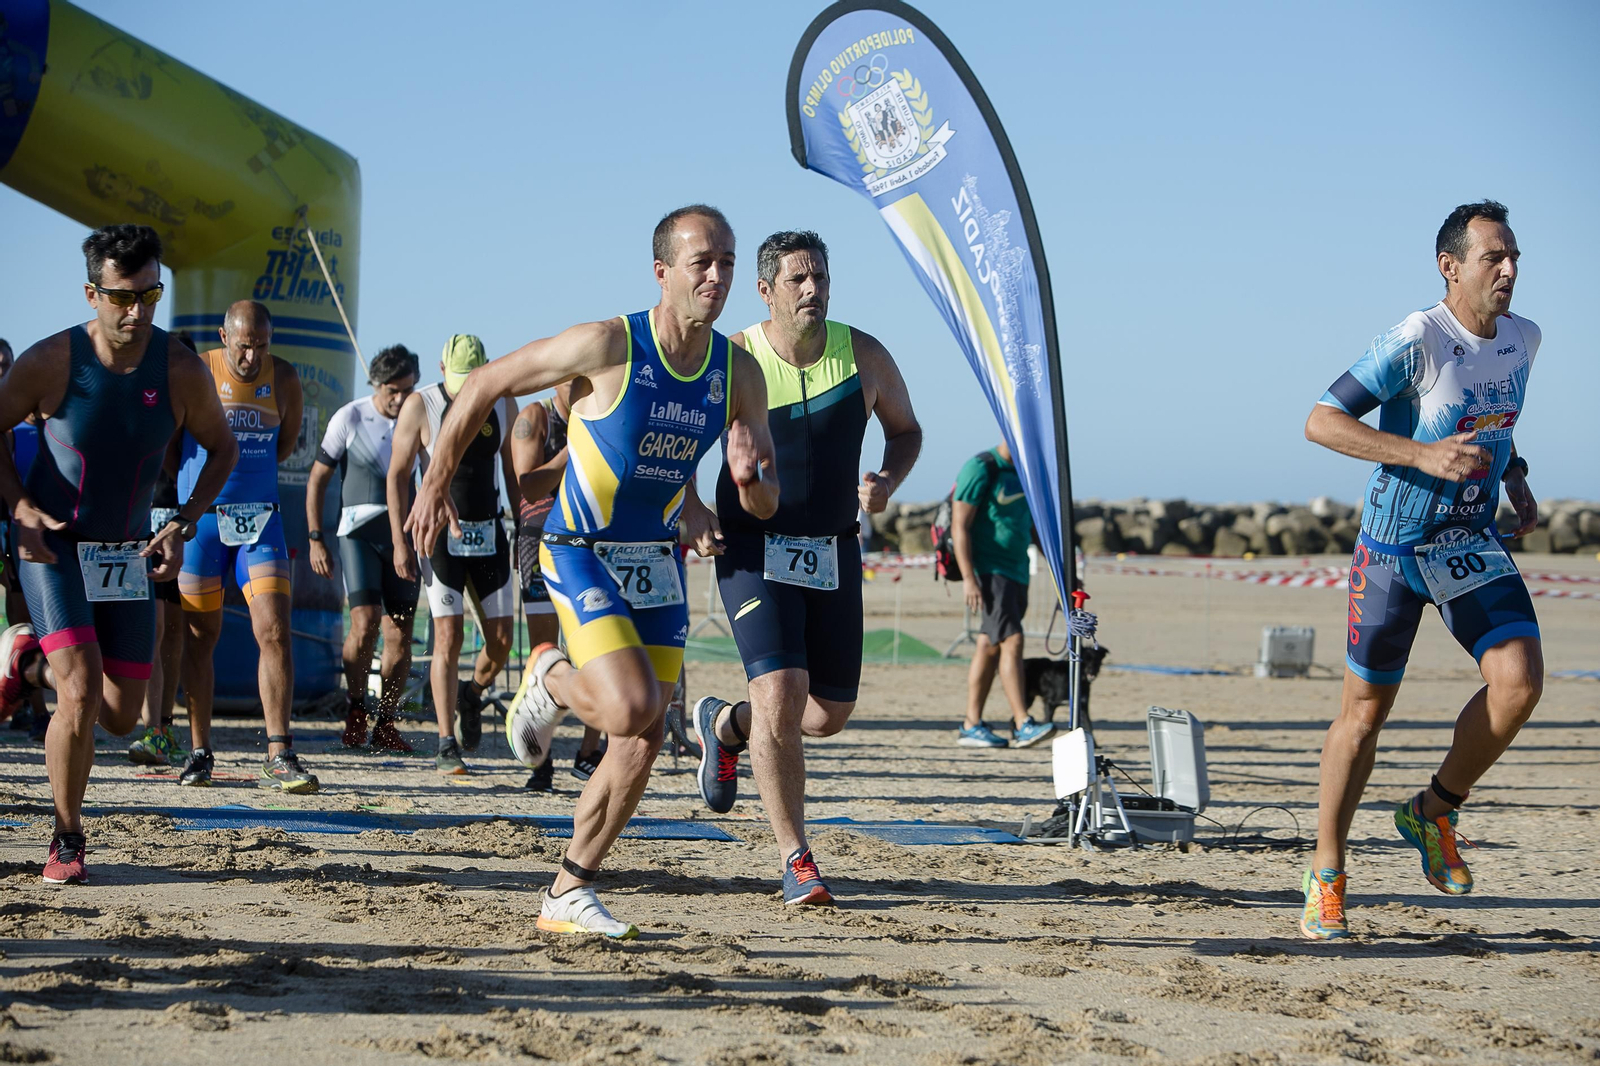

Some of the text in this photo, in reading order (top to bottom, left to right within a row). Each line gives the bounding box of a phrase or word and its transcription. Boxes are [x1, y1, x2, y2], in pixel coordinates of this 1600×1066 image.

[1472, 378, 1514, 398] JIMÉNEZ
[1467, 400, 1518, 415] Club Deportivo
[638, 431, 699, 461] GARCIA
[1435, 503, 1486, 516] DUQUE
[462, 531, 485, 546] 86
[98, 561, 128, 588] 77
[786, 547, 818, 576] 79
[1445, 551, 1487, 580] 80
[616, 565, 653, 594] 78
